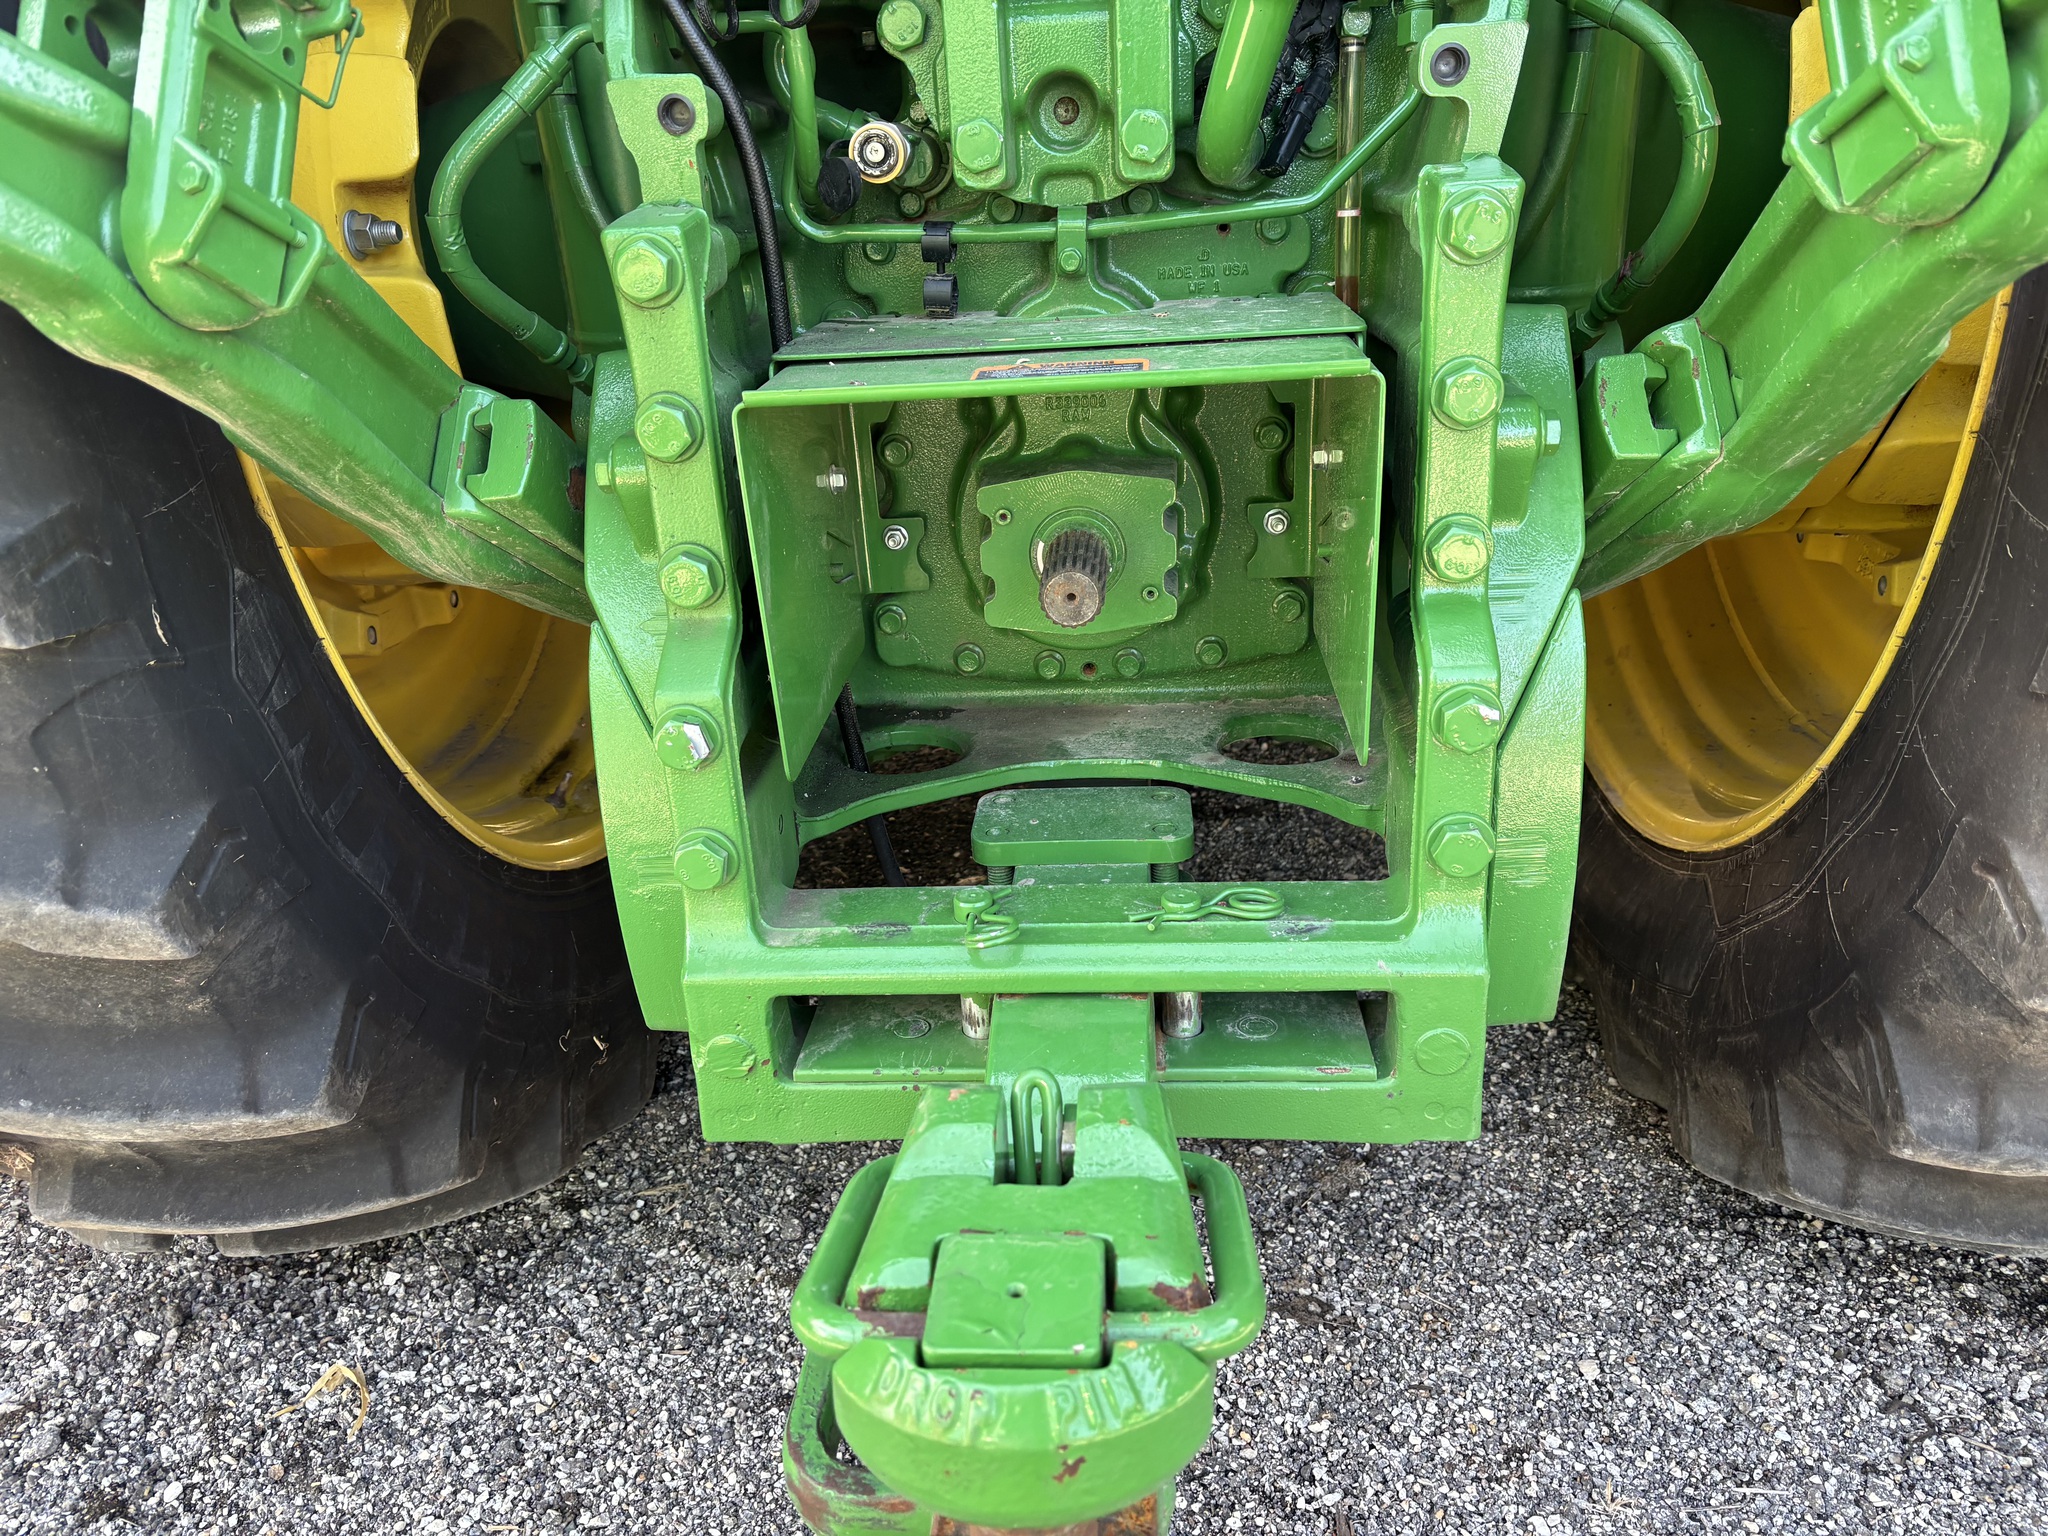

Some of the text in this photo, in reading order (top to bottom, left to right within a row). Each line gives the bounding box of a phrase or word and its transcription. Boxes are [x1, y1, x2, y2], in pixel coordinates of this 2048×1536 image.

[1157, 262, 1250, 280] MADE IN USA
[866, 1354, 1150, 1443] DROP PIN
